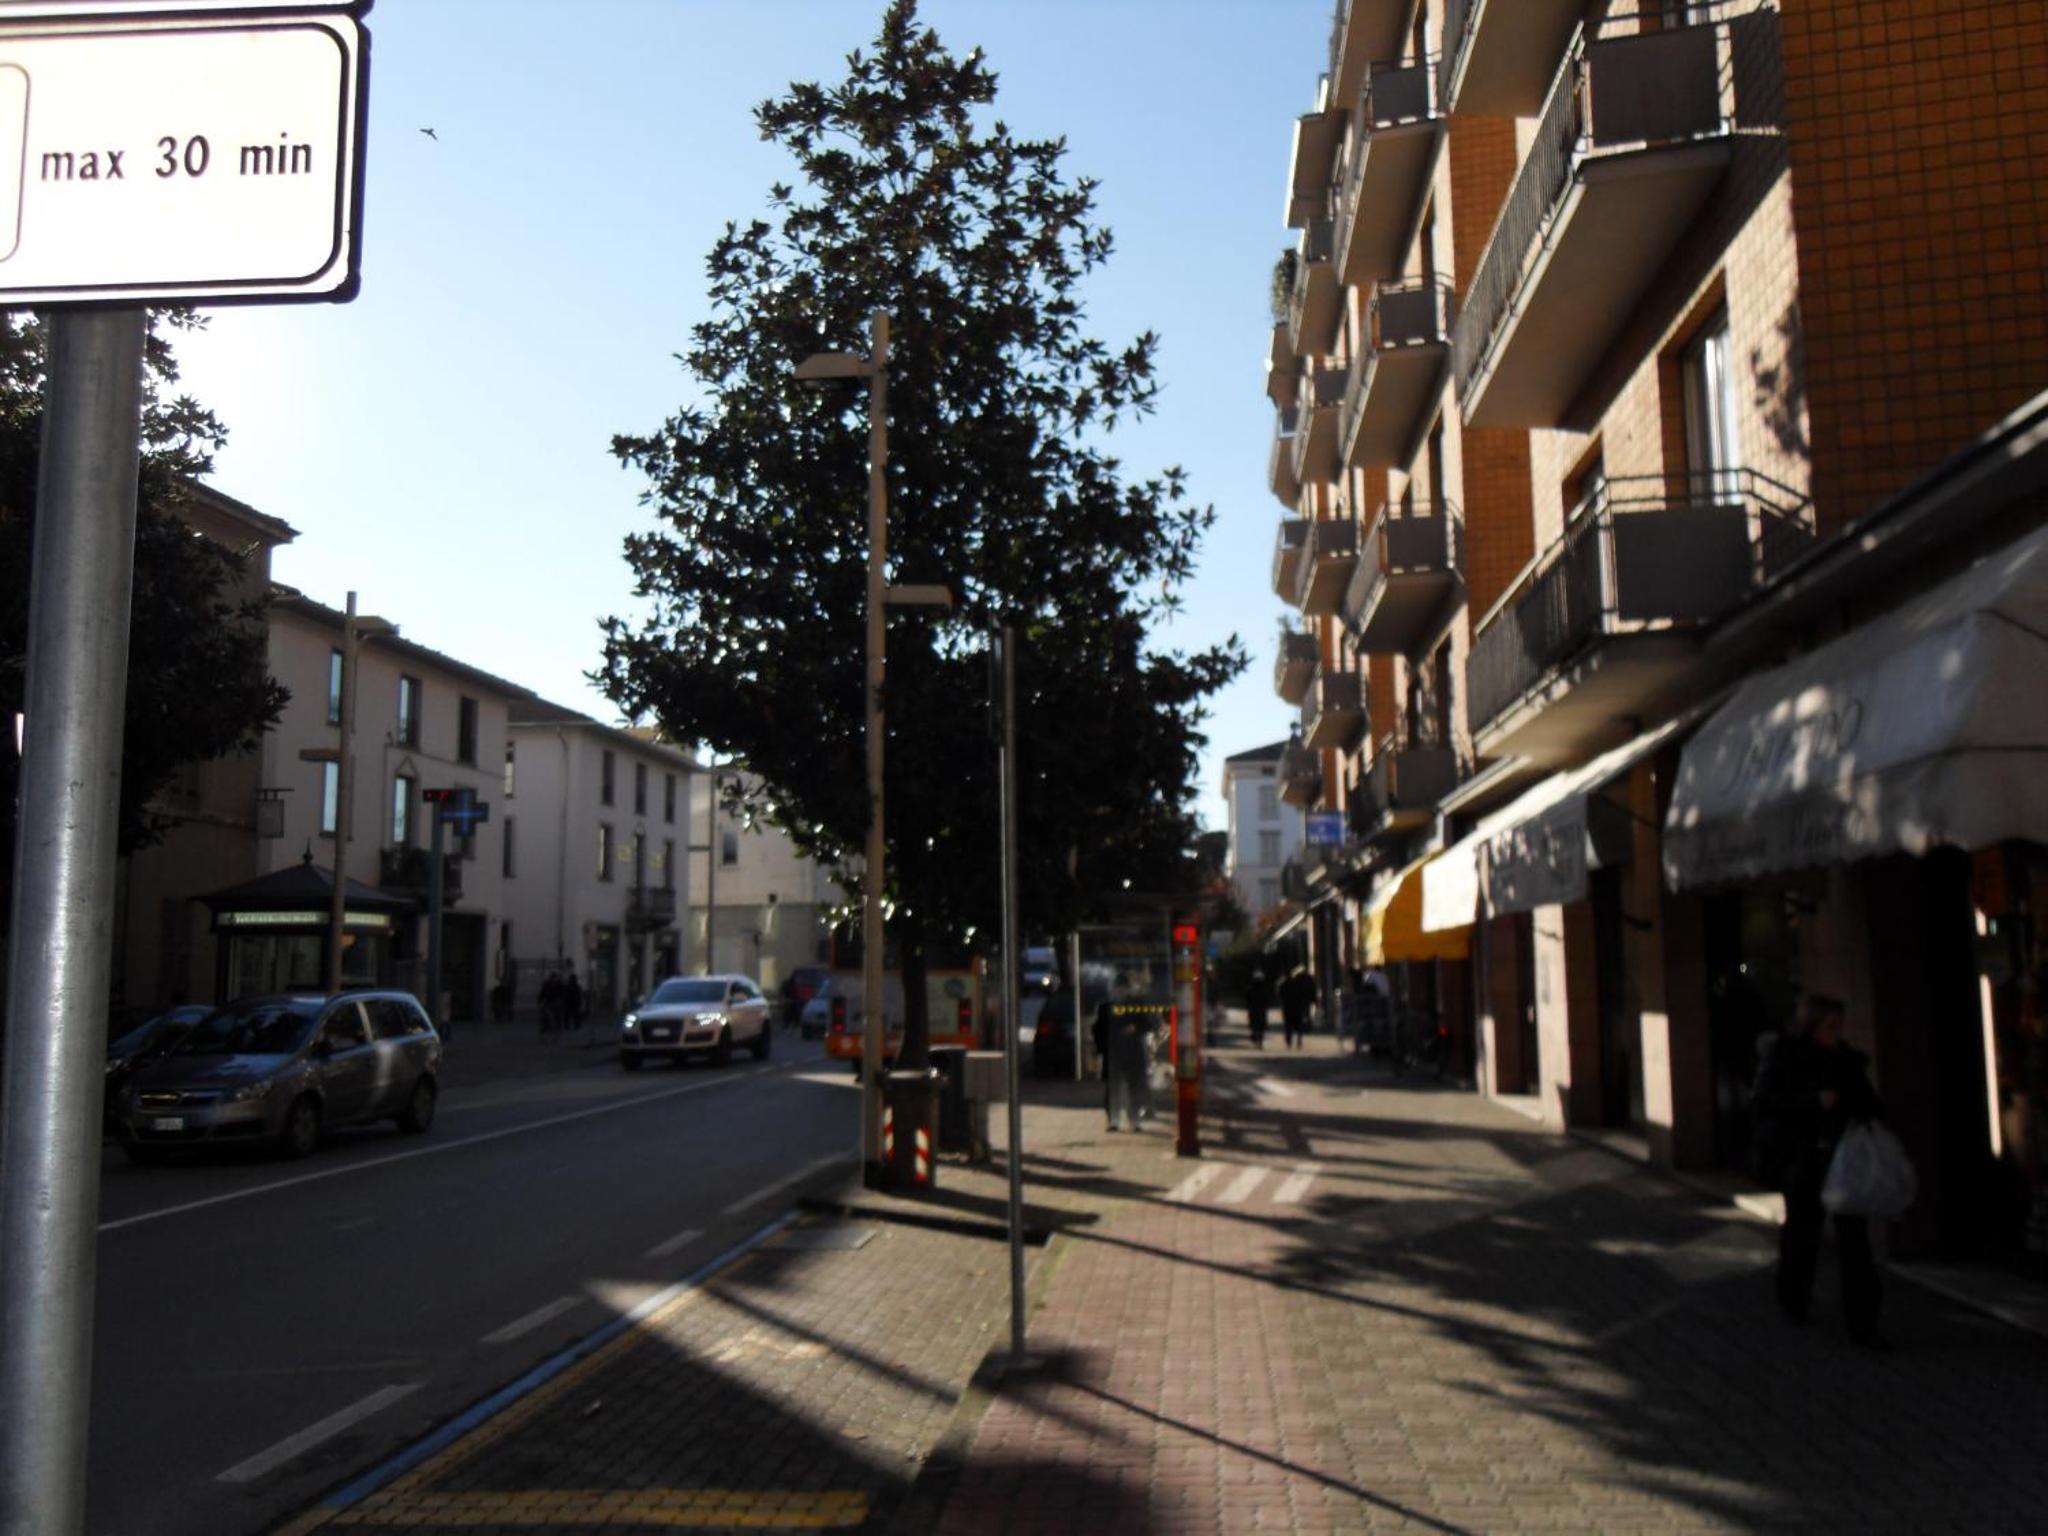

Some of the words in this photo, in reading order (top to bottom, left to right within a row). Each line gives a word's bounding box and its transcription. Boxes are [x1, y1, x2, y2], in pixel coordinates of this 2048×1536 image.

[42, 151, 123, 179] max
[156, 135, 209, 177] 30
[240, 133, 311, 174] min
